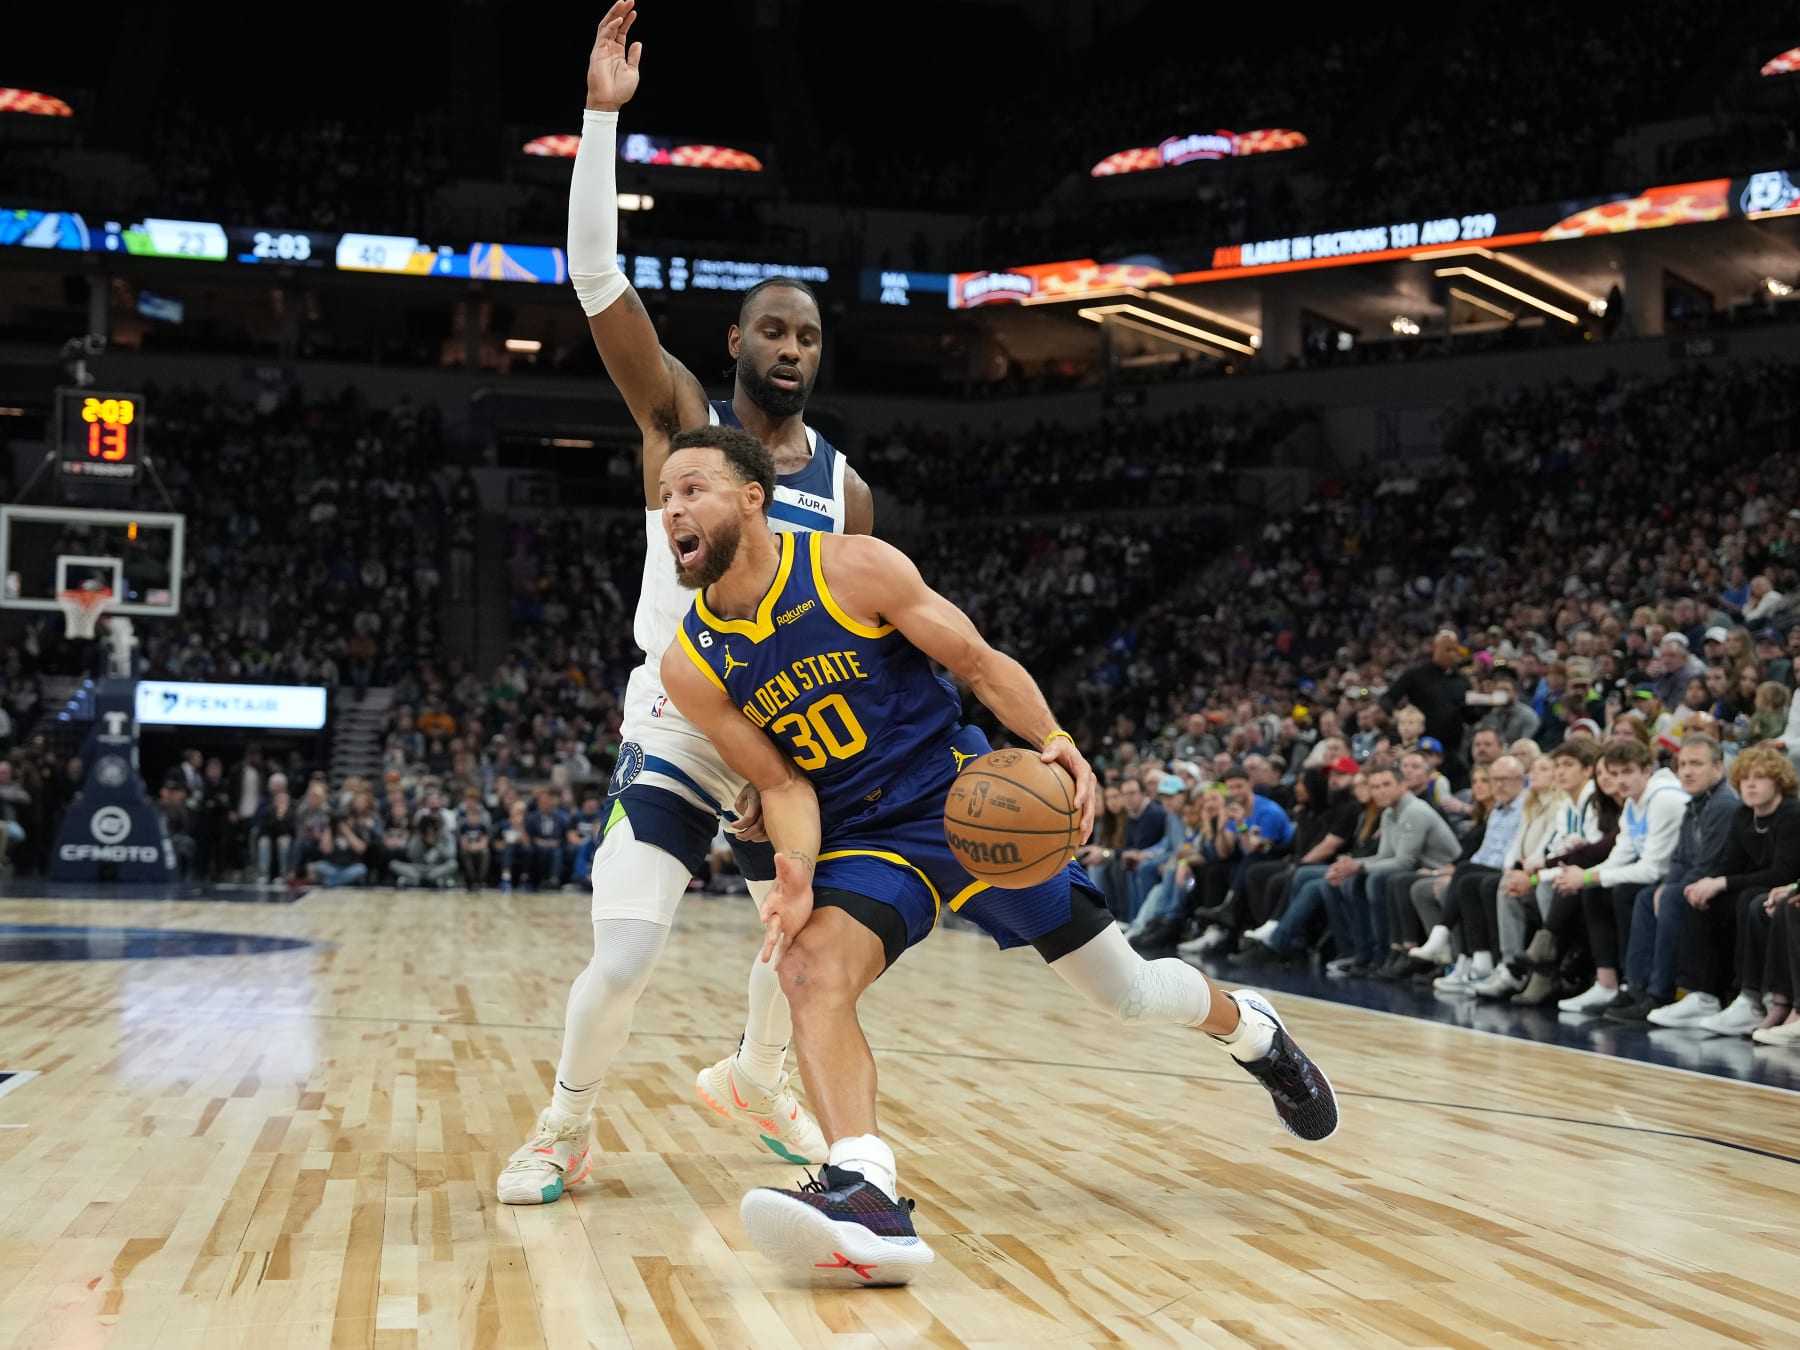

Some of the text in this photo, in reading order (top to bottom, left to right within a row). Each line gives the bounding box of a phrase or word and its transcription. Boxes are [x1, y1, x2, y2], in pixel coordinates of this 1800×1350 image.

[253, 231, 311, 260] 2:03
[1291, 236, 1312, 260] IN
[1312, 226, 1388, 258] SECTIONS
[1390, 222, 1419, 249] 131
[1420, 217, 1461, 245] AND
[1461, 212, 1497, 240] 229
[82, 397, 134, 424] 2:03
[88, 422, 127, 461] 13
[776, 599, 816, 626] Rakuten
[698, 630, 714, 648] 6
[184, 695, 279, 712] PENTAIR
[742, 650, 868, 729] OLDEN STATE
[770, 693, 868, 771] 30
[60, 843, 158, 864] CFMOTO
[945, 826, 1023, 865] Wilson
